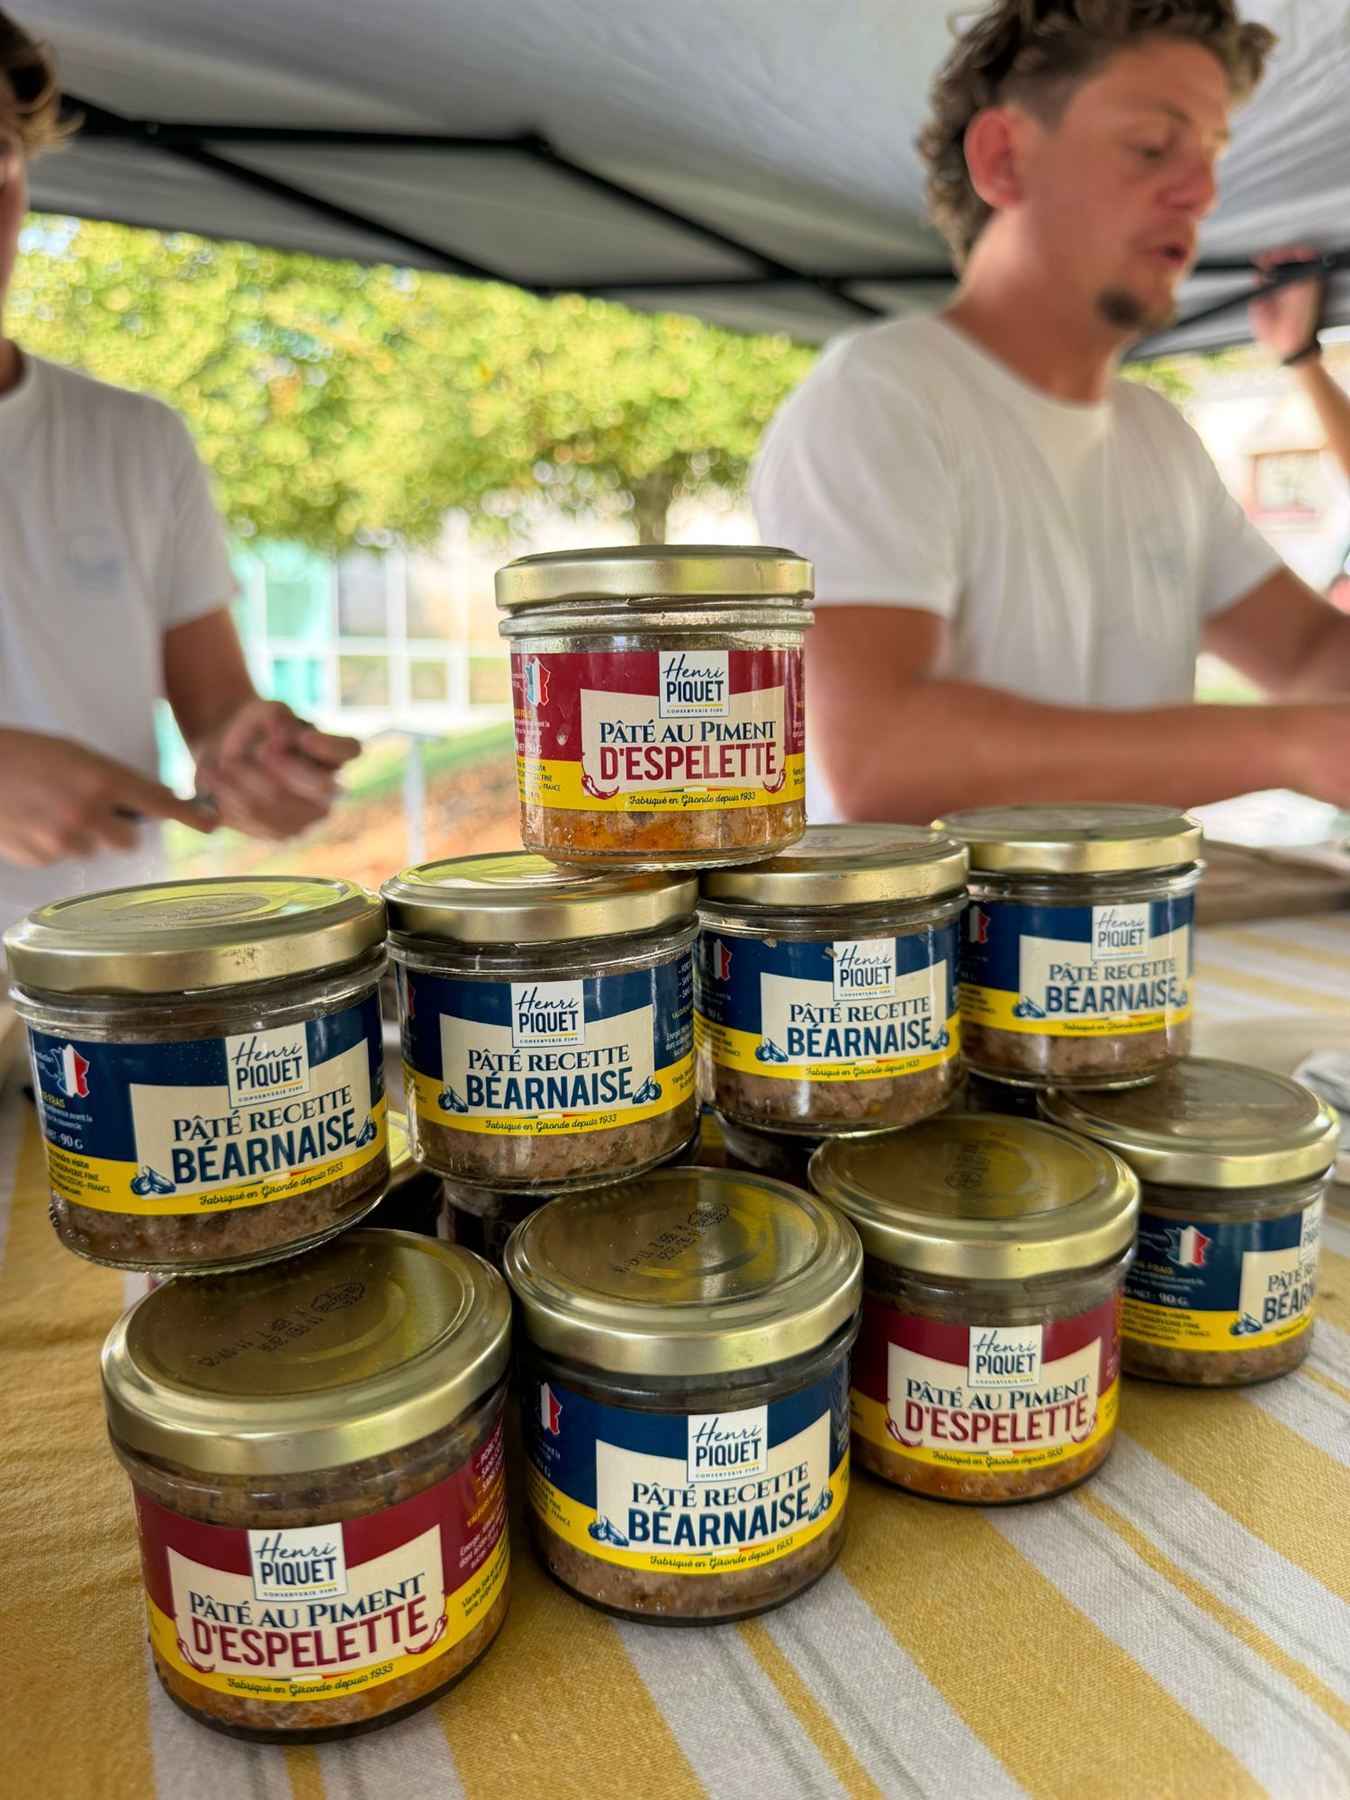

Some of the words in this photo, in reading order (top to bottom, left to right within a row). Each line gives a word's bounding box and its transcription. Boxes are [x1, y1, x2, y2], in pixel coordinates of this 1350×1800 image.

[663, 654, 724, 679] Henri
[666, 680, 723, 704] PIQUET
[600, 721, 654, 743] PÂTÉ
[660, 723, 695, 743] AU
[700, 720, 776, 741] PIMENT
[600, 741, 776, 781] D'ESPELETTE
[668, 797, 679, 805] en
[681, 794, 714, 806] Gironde
[715, 794, 739, 805] depuis
[740, 792, 755, 800] 1933
[1095, 909, 1144, 929] Henri
[1098, 929, 1145, 948] PIQUET
[836, 945, 891, 967] Henri
[1049, 962, 1098, 982] PÂTÉ
[1103, 957, 1175, 980] RECETTE
[840, 966, 891, 988] PIQUET
[515, 986, 579, 1012] Henri
[790, 1002, 841, 1023] PÂTÉ
[847, 996, 930, 1022] RECETTE
[1045, 977, 1177, 1013] BÉARNAISE
[519, 1011, 579, 1034] PIQUET
[787, 1017, 932, 1057] BÉARNAISE
[232, 1035, 302, 1066] Henri
[467, 1048, 522, 1072] PÂTÉ
[528, 1044, 629, 1071] RECETTE
[236, 1056, 303, 1091] PIQUET
[466, 1066, 634, 1111] BÉARNAISE
[173, 1109, 242, 1142] PÂTÉ
[249, 1085, 352, 1130] RECETTE
[523, 1122, 534, 1130] en
[535, 1120, 570, 1133] Gironde
[571, 1118, 598, 1131] depuis
[599, 1113, 617, 1124] 1933
[171, 1108, 357, 1184] BÉARNAISE
[246, 1190, 260, 1199] en
[261, 1181, 300, 1199] Gironde
[301, 1171, 326, 1188] depuis
[327, 1163, 344, 1177] 1933
[973, 1331, 1036, 1356] Henri
[975, 1353, 1036, 1375] PIQUET
[906, 1377, 963, 1406] PÂTÉ
[968, 1391, 1001, 1411] AU
[1008, 1375, 1090, 1410] PIMENT
[692, 1417, 763, 1443] Henri
[905, 1394, 1089, 1444] D'ESPELETTE
[696, 1438, 762, 1467] PIQUET
[631, 1481, 696, 1508] PÂTÉ
[703, 1461, 809, 1504] RECETTE
[628, 1483, 812, 1547] BÉARNAISE
[256, 1532, 337, 1564] Henri
[694, 1560, 706, 1568] en
[709, 1555, 747, 1570] Gironde
[748, 1548, 775, 1563] depuis
[776, 1537, 794, 1554] 1933
[261, 1558, 336, 1586] PIQUET
[189, 1590, 250, 1624] PÂTÉ
[258, 1606, 299, 1628] AU
[307, 1572, 425, 1627] PIMENT
[192, 1595, 428, 1667] D'ESPELETTE
[274, 1685, 286, 1693] en
[288, 1683, 333, 1697] Gironde
[334, 1674, 368, 1692] depuis
[369, 1663, 393, 1680] 1933
